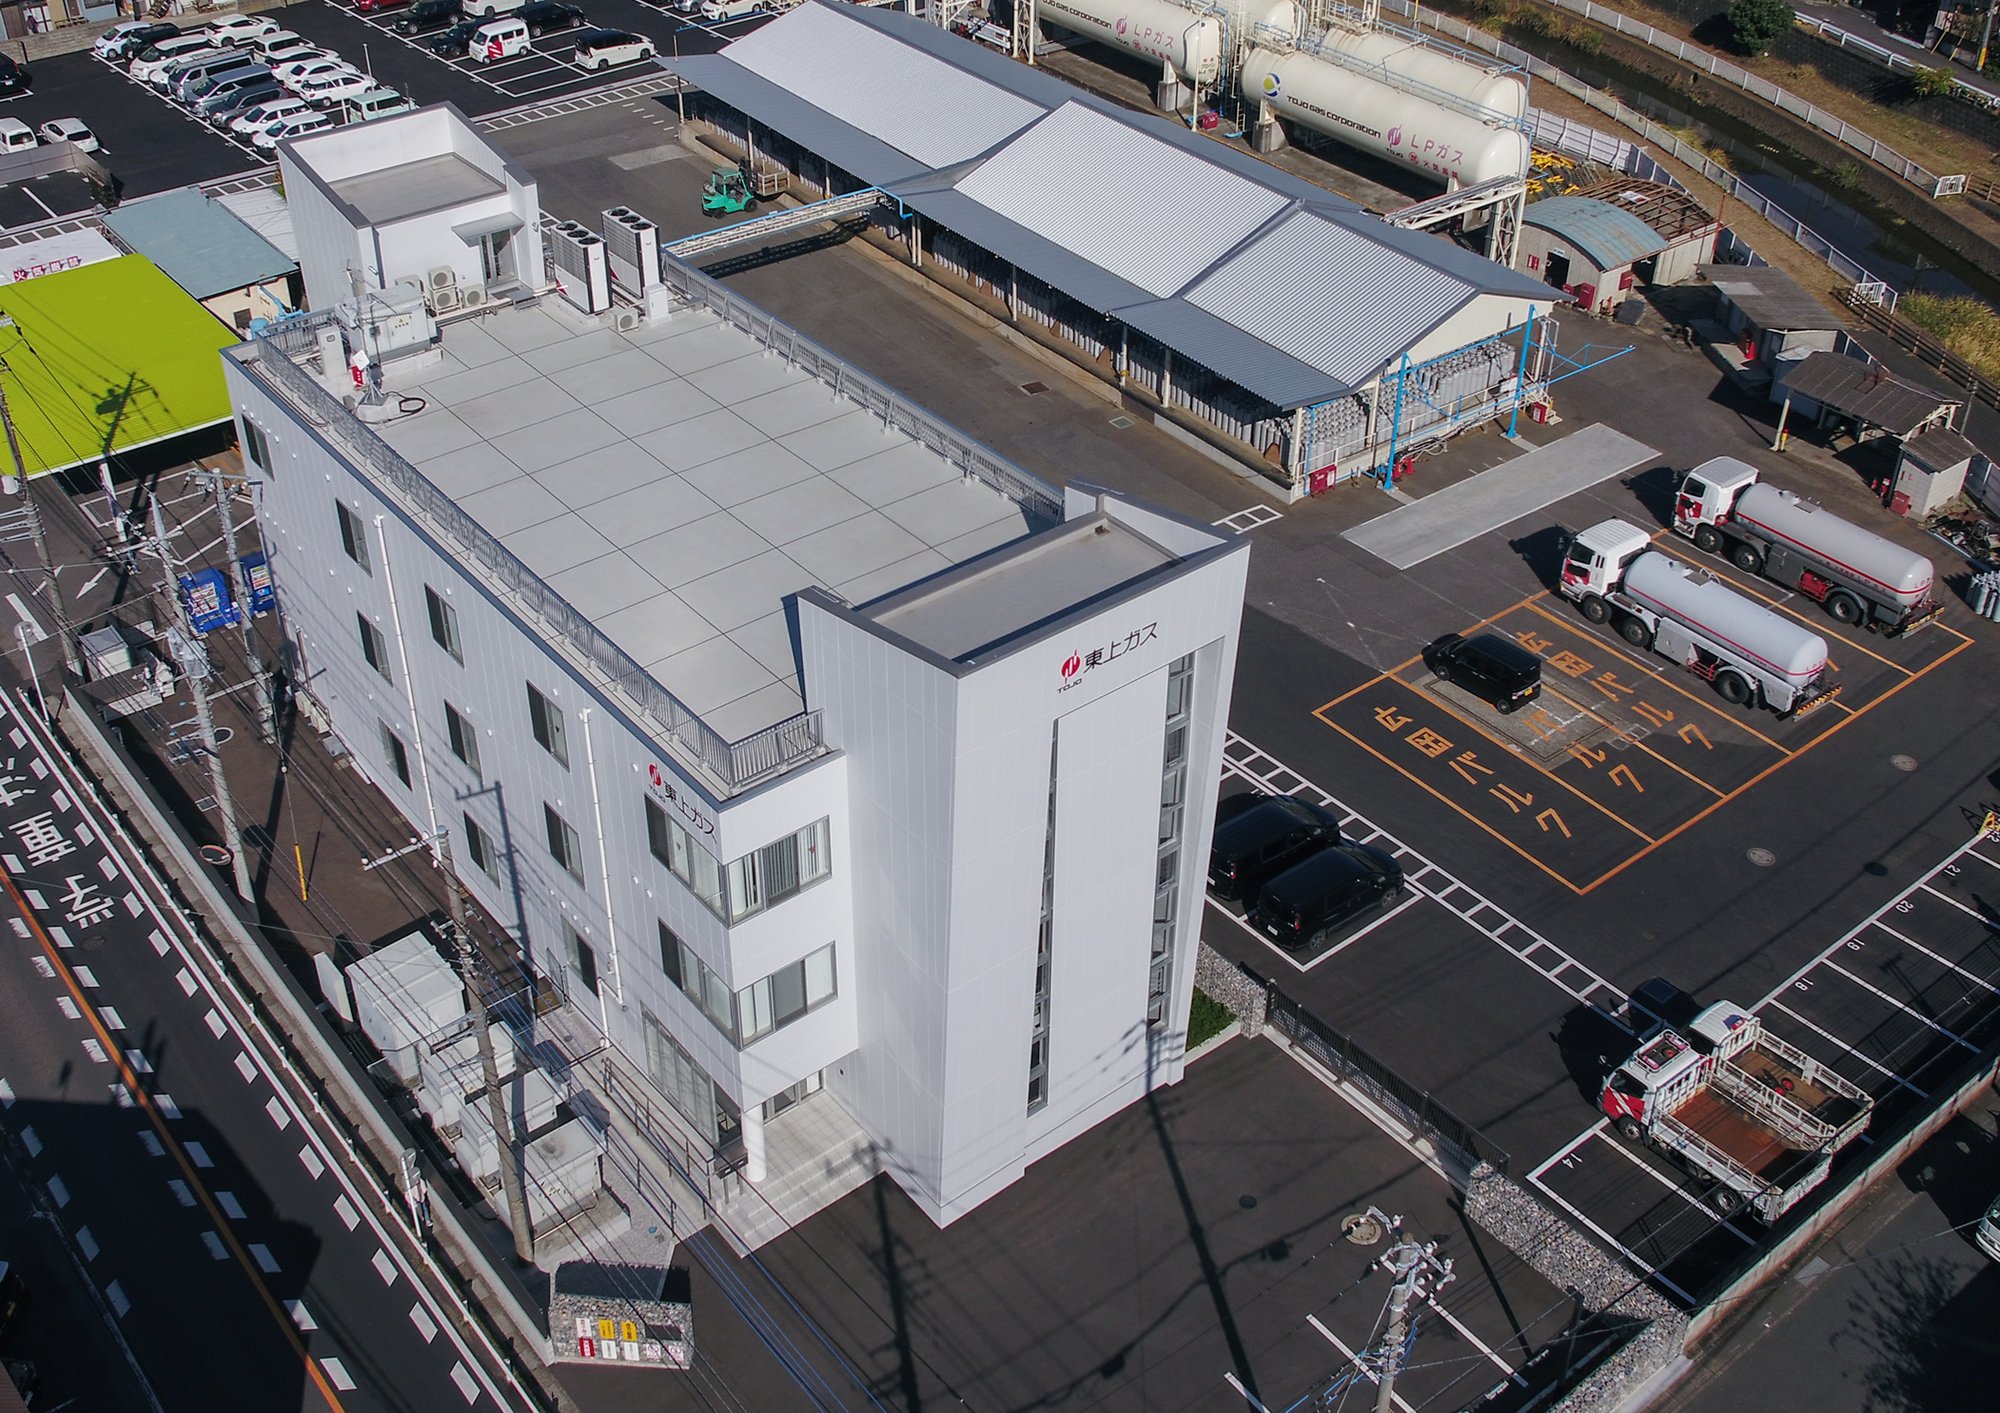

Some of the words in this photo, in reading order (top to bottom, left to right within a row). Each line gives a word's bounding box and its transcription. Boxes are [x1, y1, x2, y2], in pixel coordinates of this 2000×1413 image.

[1069, 7, 1112, 29] corporation
[1134, 23, 1174, 49] LPガス
[1286, 95, 1308, 109] TOJO
[1326, 111, 1381, 139] corporation
[1410, 134, 1463, 165] LPガス
[1083, 622, 1157, 673] 東上ガス
[1056, 678, 1082, 693] TOJO
[1374, 706, 1572, 839] 広岡バルク
[663, 780, 717, 843] 東上ガス
[1944, 864, 1961, 877] 21
[1895, 900, 1914, 914] 20
[1846, 937, 1866, 951] 19
[1794, 977, 1815, 992] 18
[1562, 1153, 1583, 1169] 14
